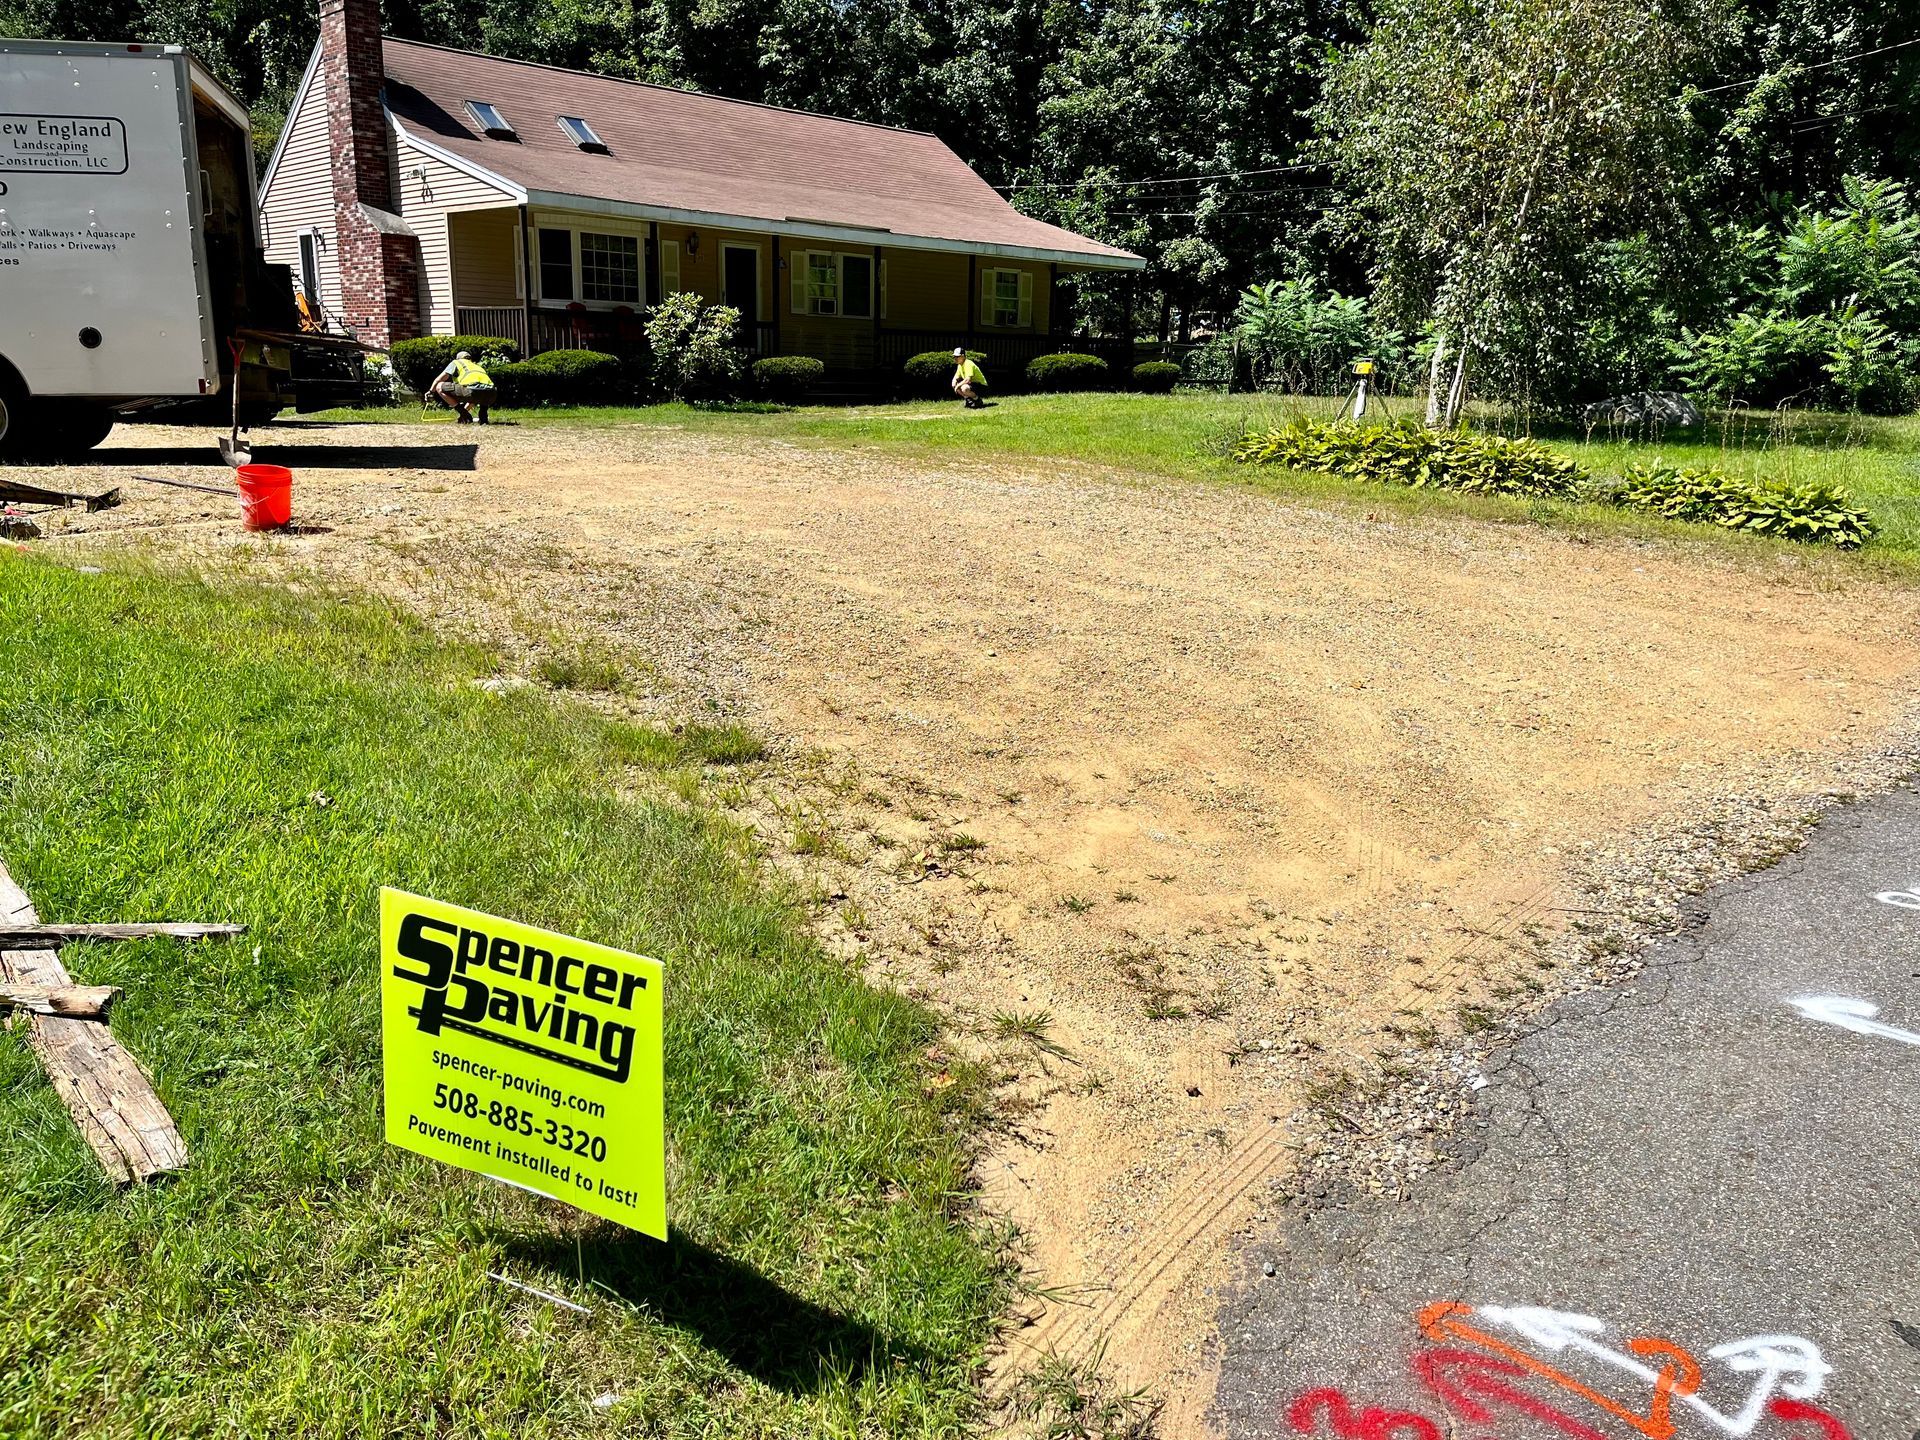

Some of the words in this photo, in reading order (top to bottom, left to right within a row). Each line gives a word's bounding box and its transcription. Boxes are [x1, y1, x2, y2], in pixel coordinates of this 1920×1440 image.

[0, 123, 28, 135] ew
[37, 120, 111, 140] England
[13, 139, 89, 153] Landscaping
[87, 157, 109, 167] LLC
[0, 229, 17, 238] ork
[28, 228, 75, 239] Walkways
[85, 229, 136, 241] Aquascape
[0, 241, 17, 250] alls
[28, 241, 58, 250] Patios
[68, 241, 117, 252] Driveways
[393, 913, 647, 1010] Spencer
[410, 974, 636, 1083] Paving
[432, 1049, 606, 1119] spencer-paving.com
[433, 1083, 607, 1163] 508-885-3320
[408, 1114, 492, 1156] Pavement
[495, 1142, 572, 1183] installed
[575, 1167, 594, 1191] to
[597, 1178, 639, 1210] last!
